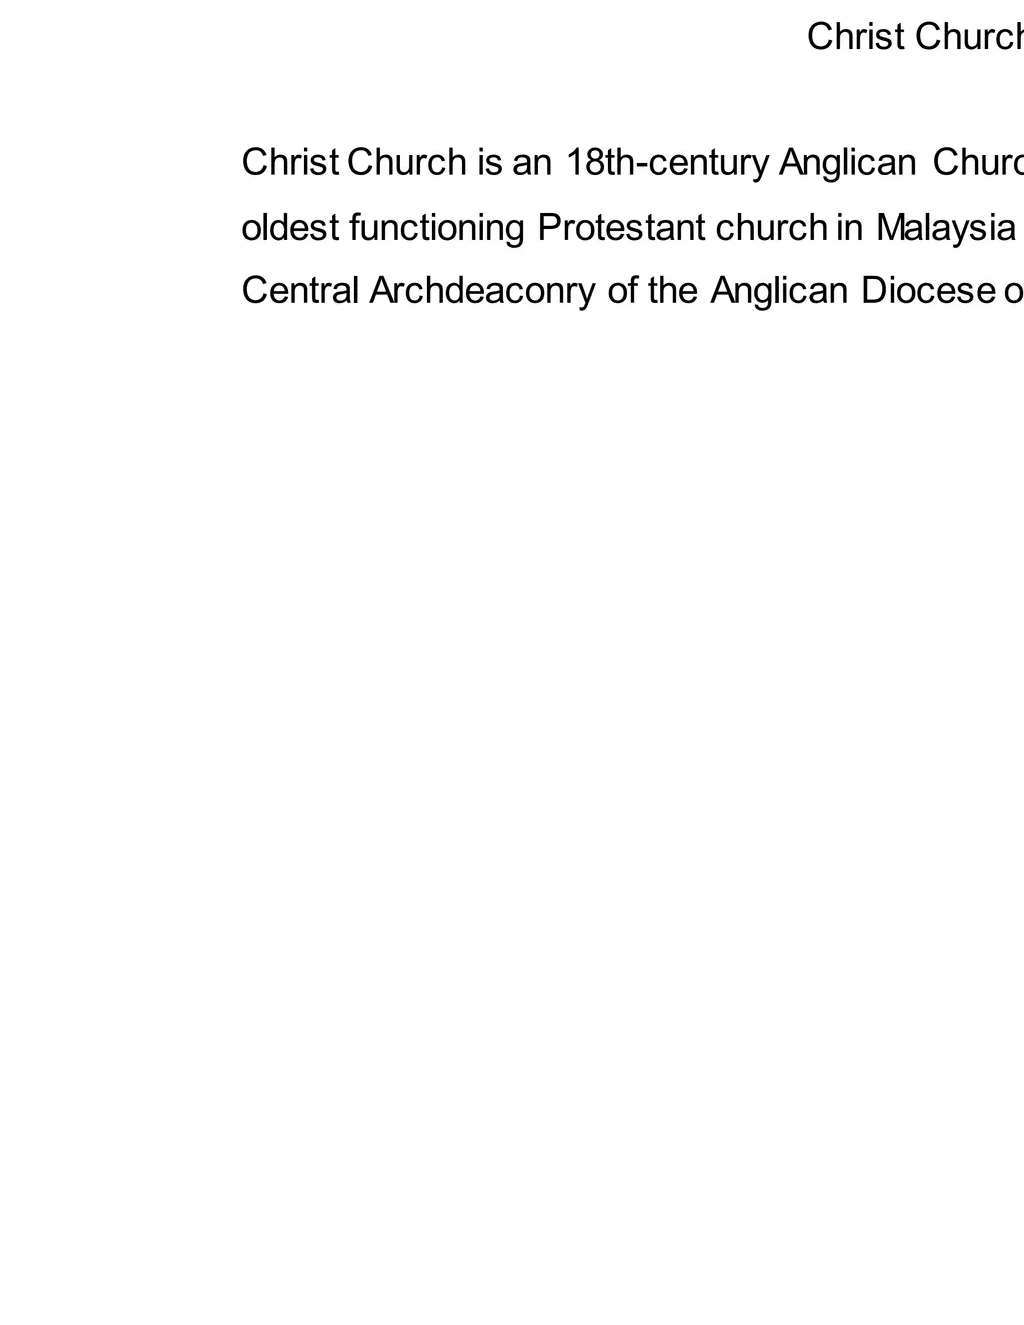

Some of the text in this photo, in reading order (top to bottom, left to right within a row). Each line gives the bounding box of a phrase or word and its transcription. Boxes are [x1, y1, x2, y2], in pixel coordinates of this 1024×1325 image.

[807, 20, 906, 51] Christ
[242, 146, 340, 176] Christ
[347, 146, 466, 176] Church
[478, 146, 503, 176] is
[512, 153, 552, 176] an
[568, 146, 770, 184] 18th-century
[778, 146, 916, 184] Anglican
[241, 212, 340, 242] oldest
[348, 211, 524, 249] functioning
[539, 212, 706, 242] Protestant
[716, 212, 828, 242] church
[837, 212, 863, 241] in
[877, 212, 1016, 249] Malaysia
[242, 274, 358, 304] Central
[368, 275, 597, 312] Archdeaconry
[608, 274, 640, 304] of
[647, 275, 698, 304] the
[709, 275, 848, 312] Anglican
[862, 275, 997, 304] Diocese
